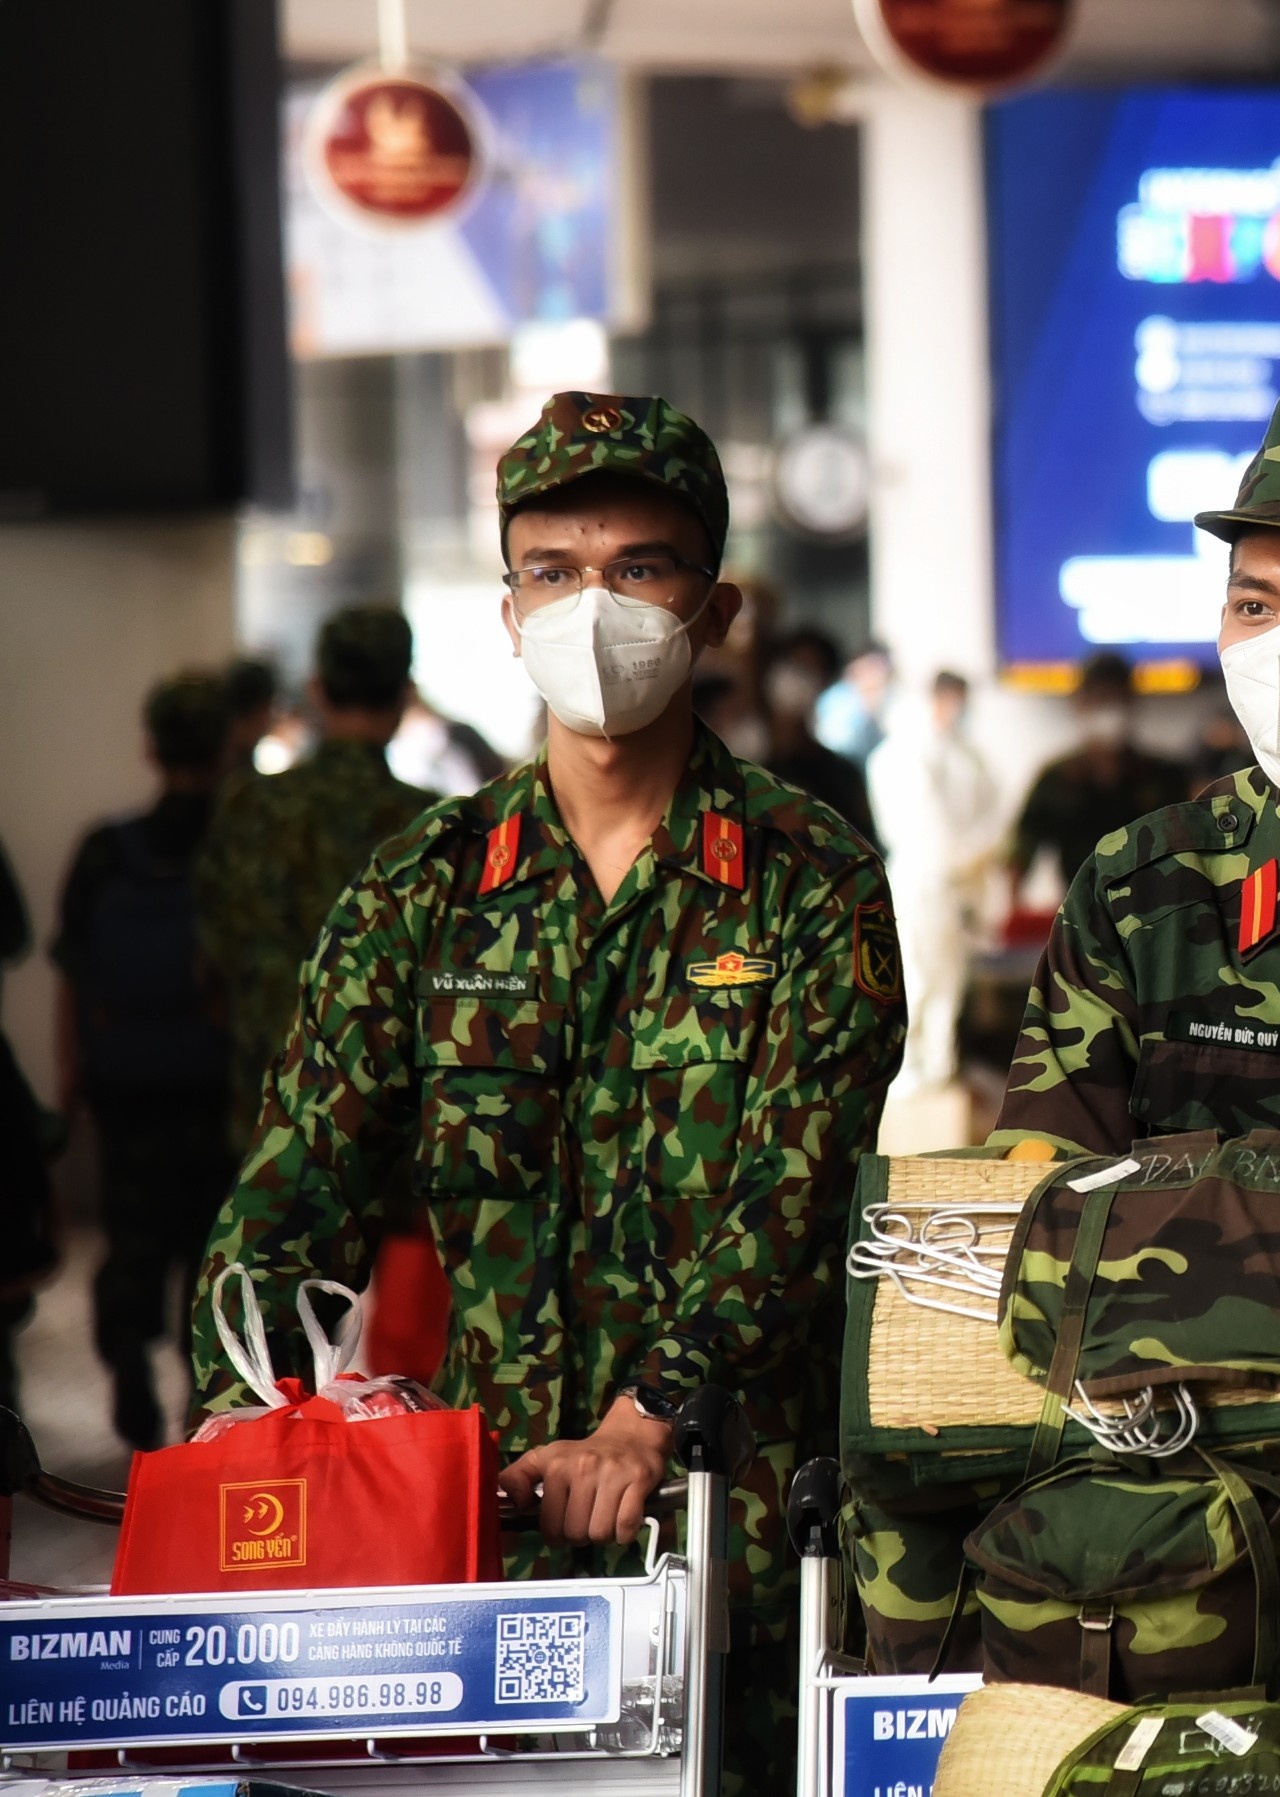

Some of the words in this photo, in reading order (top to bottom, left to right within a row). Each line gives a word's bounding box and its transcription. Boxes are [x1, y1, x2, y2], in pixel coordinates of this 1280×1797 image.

[432, 972, 454, 990] VŨ
[455, 974, 493, 990] XUÂN
[1189, 1021, 1233, 1042] NGUYỄN
[1234, 1026, 1255, 1045] ĐỨC
[231, 1540, 265, 1561] SONG
[149, 1629, 180, 1645] CUNG
[309, 1622, 324, 1638] XE
[352, 1618, 384, 1636] HÀNH
[387, 1617, 404, 1635] LÝ
[404, 1618, 422, 1636] TẠI
[424, 1615, 447, 1633] CÁC
[10, 1630, 132, 1661] BIZMAN
[185, 1622, 300, 1667] 20.000
[308, 1641, 340, 1661] CẢNG
[341, 1641, 373, 1660] HÀNG
[374, 1641, 414, 1659] KHÔNG
[415, 1636, 446, 1656] QUỐC
[448, 1635, 464, 1655] TẾ
[100, 1660, 130, 1670] Media
[156, 1647, 180, 1668] CẤP
[8, 1698, 54, 1725] LIÊN
[59, 1695, 87, 1726] HỆ
[91, 1691, 161, 1721] QUẢNG
[165, 1690, 206, 1718] CÁO
[277, 1681, 442, 1712] 094.986.98.98
